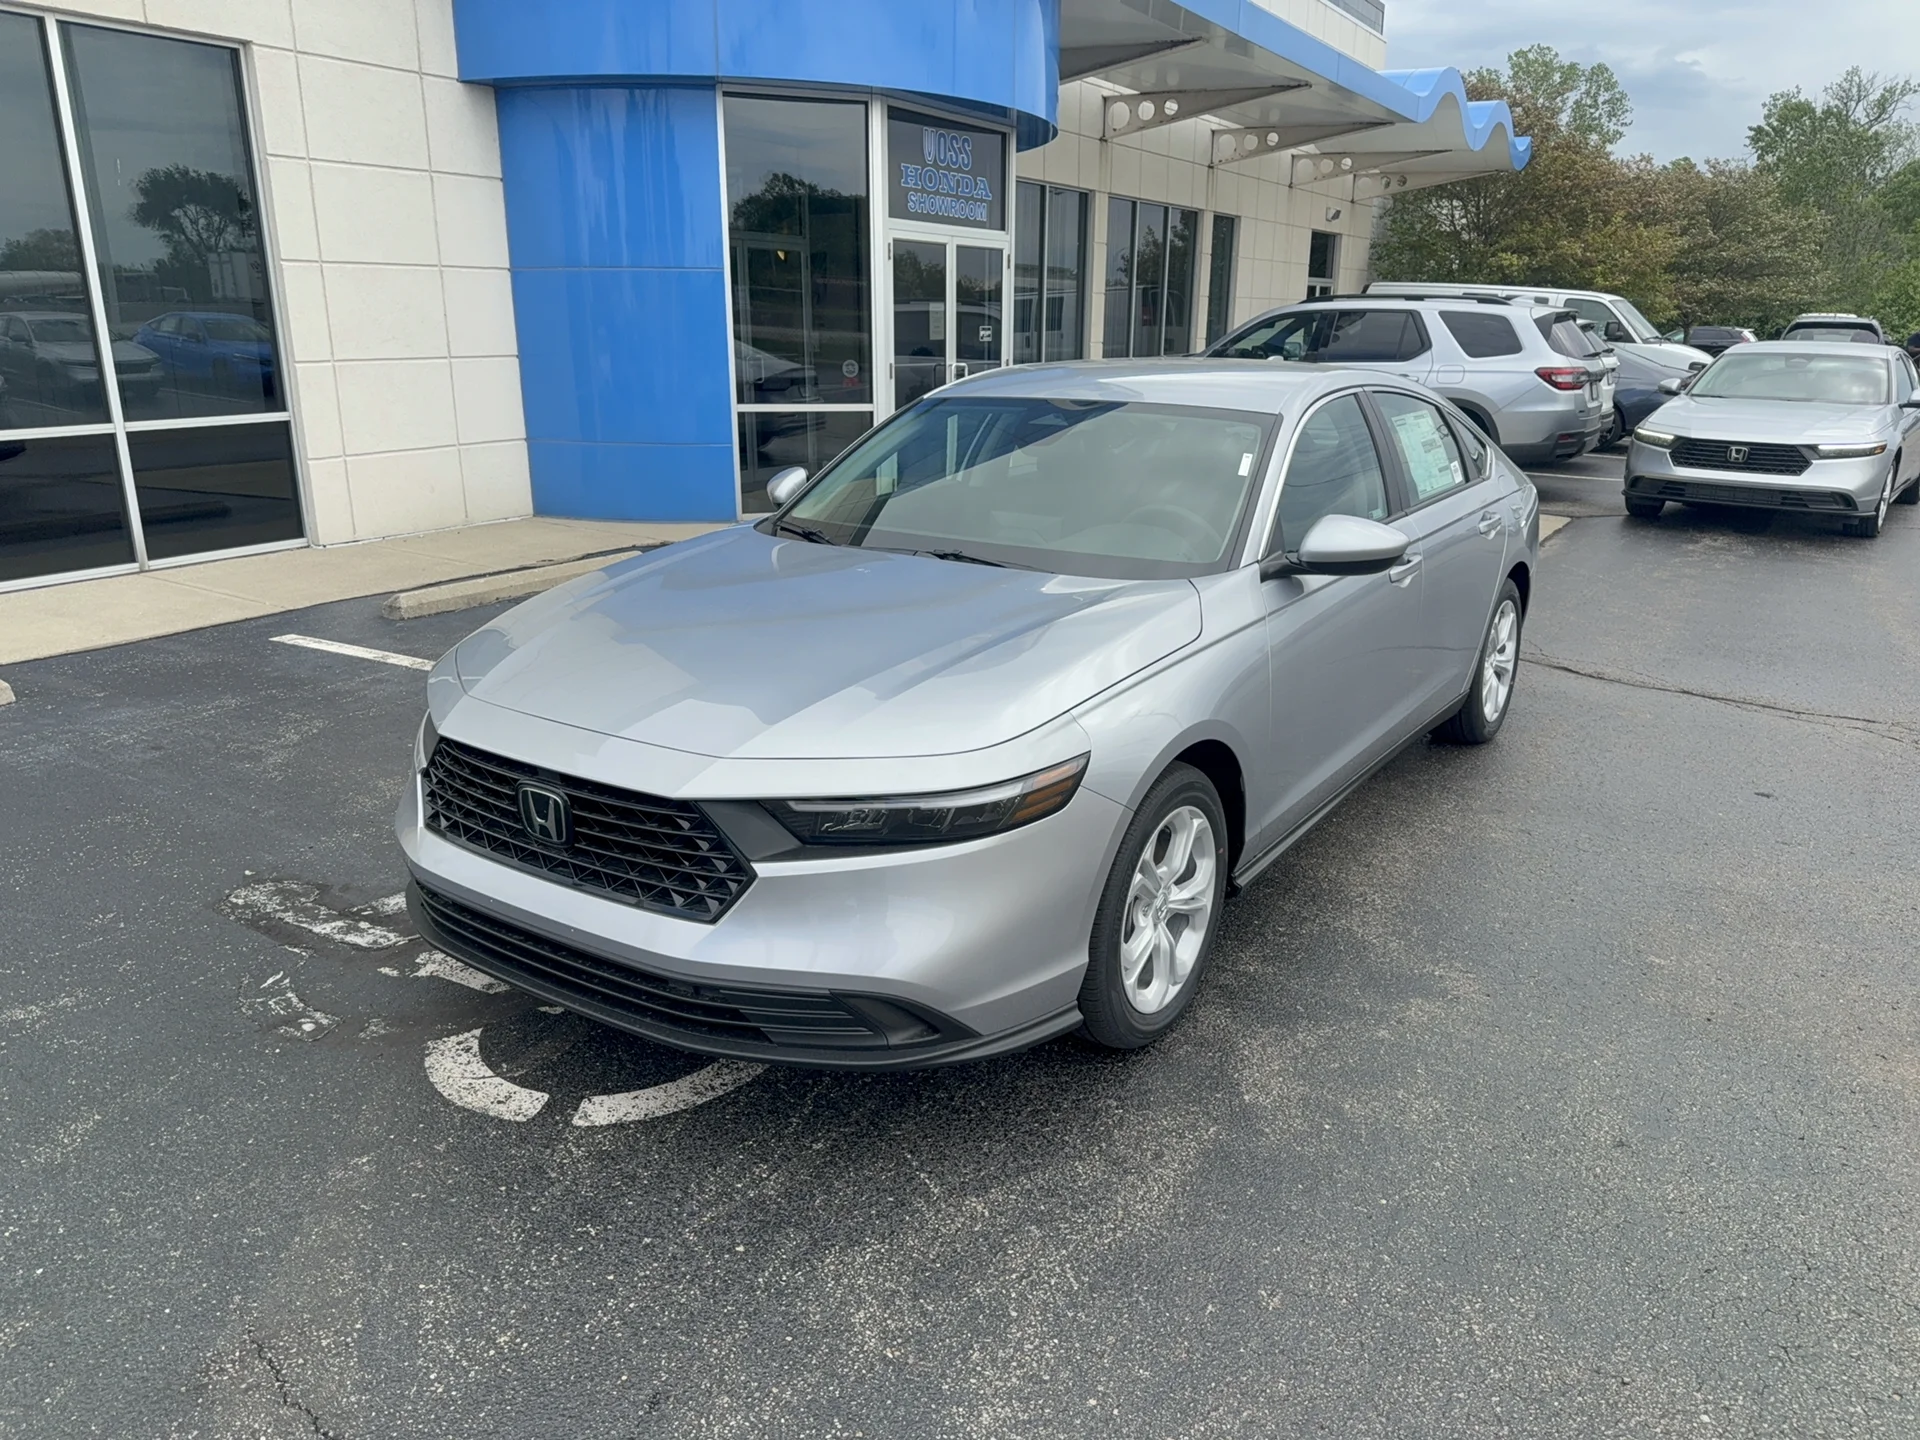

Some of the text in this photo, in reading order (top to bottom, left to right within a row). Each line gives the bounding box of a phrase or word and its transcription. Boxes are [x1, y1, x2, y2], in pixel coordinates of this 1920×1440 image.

[923, 127, 972, 170] VOSS
[901, 163, 992, 200] HONDA
[908, 191, 987, 221] SHOWROOM
